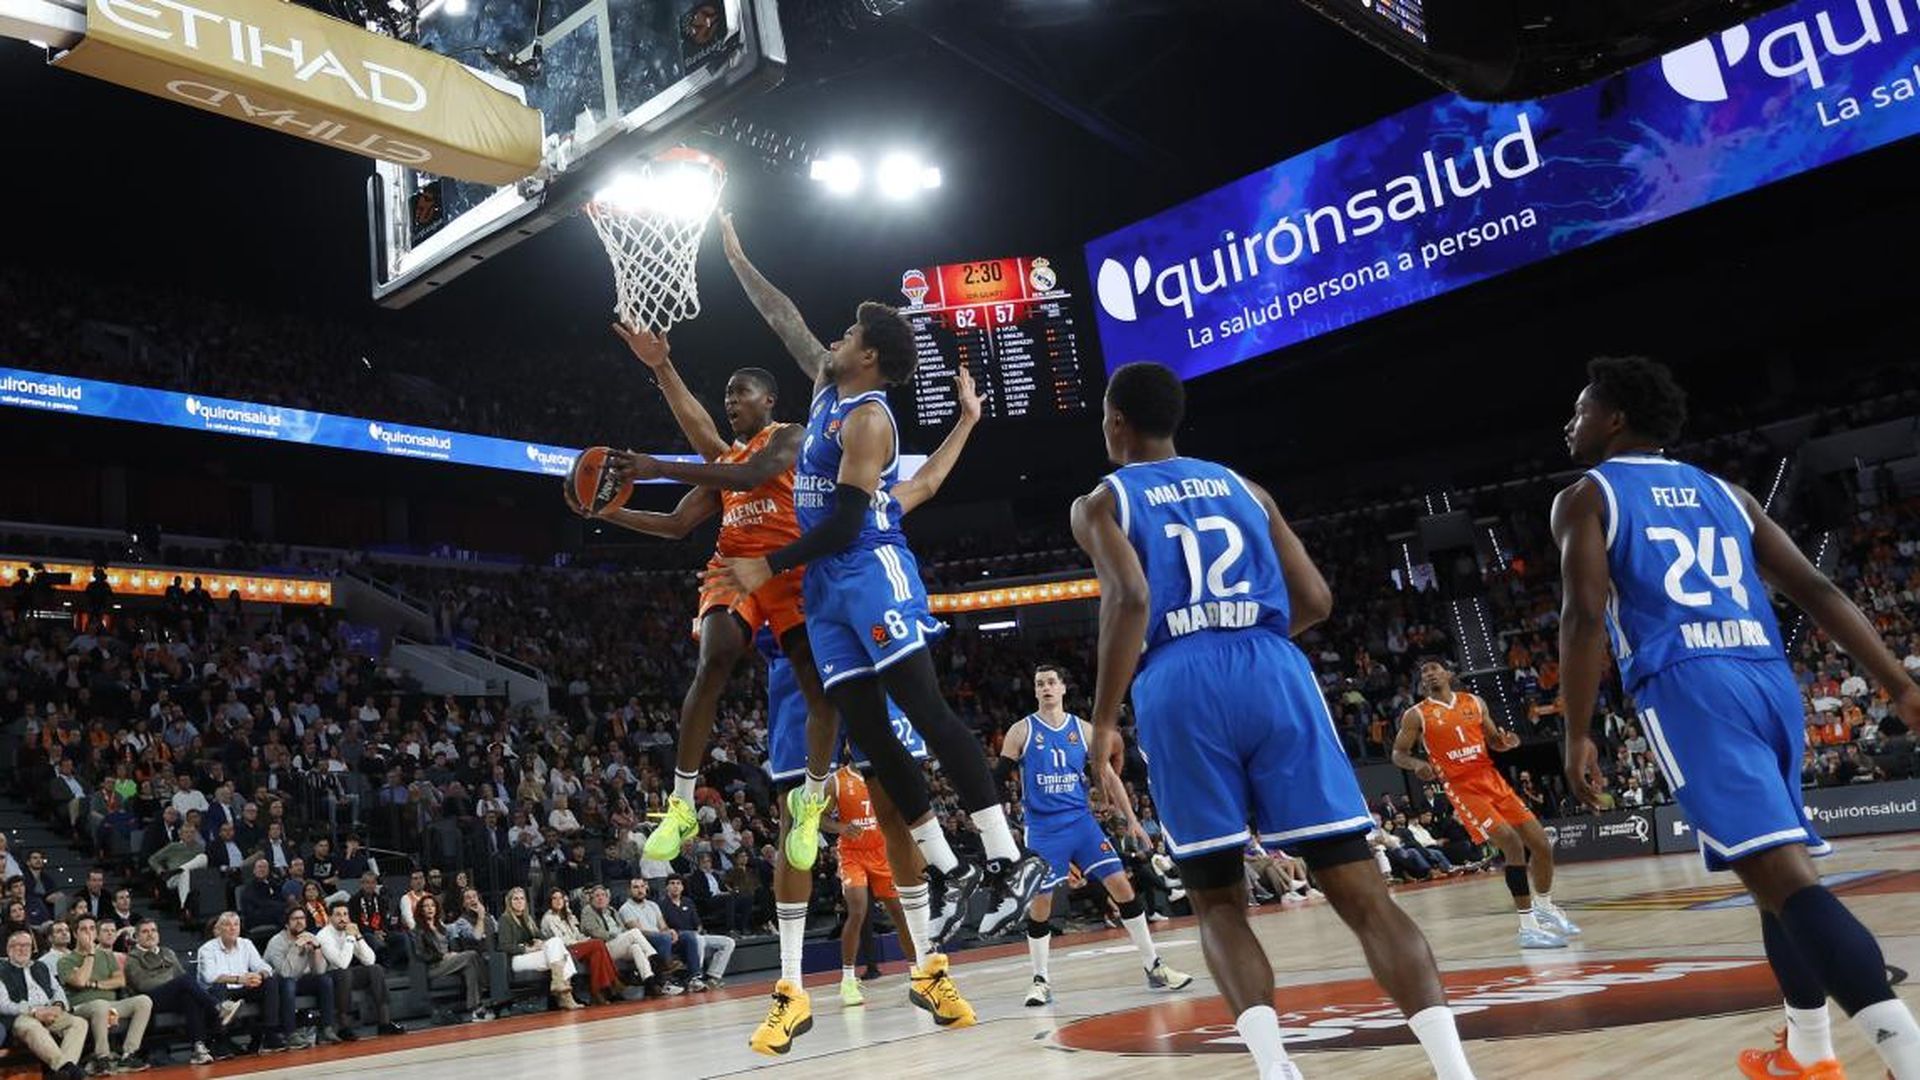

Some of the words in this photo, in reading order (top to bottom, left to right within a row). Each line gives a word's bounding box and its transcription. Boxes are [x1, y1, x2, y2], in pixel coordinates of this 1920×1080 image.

[95, 0, 427, 112] ETIHAD
[166, 79, 432, 164] ETIHAD
[1816, 96, 1861, 127] La
[1154, 111, 1541, 319] quirónsalud
[964, 262, 1002, 284] 2:30
[1187, 323, 1215, 350] La
[1219, 296, 1284, 338] salud
[1286, 261, 1391, 317] persona
[1397, 253, 1414, 271] a
[1420, 207, 1538, 268] persona
[956, 309, 976, 327] 62
[995, 304, 1014, 322] 57
[1145, 478, 1231, 506] MALEDON
[1651, 486, 1701, 508] FELIZ
[1164, 515, 1250, 604] 12
[1645, 526, 1749, 611] 24
[884, 608, 909, 640] 8
[1166, 601, 1259, 637] MADRID
[1455, 725, 1465, 743] 1
[1050, 748, 1067, 768] 11
[861, 800, 871, 817] 7
